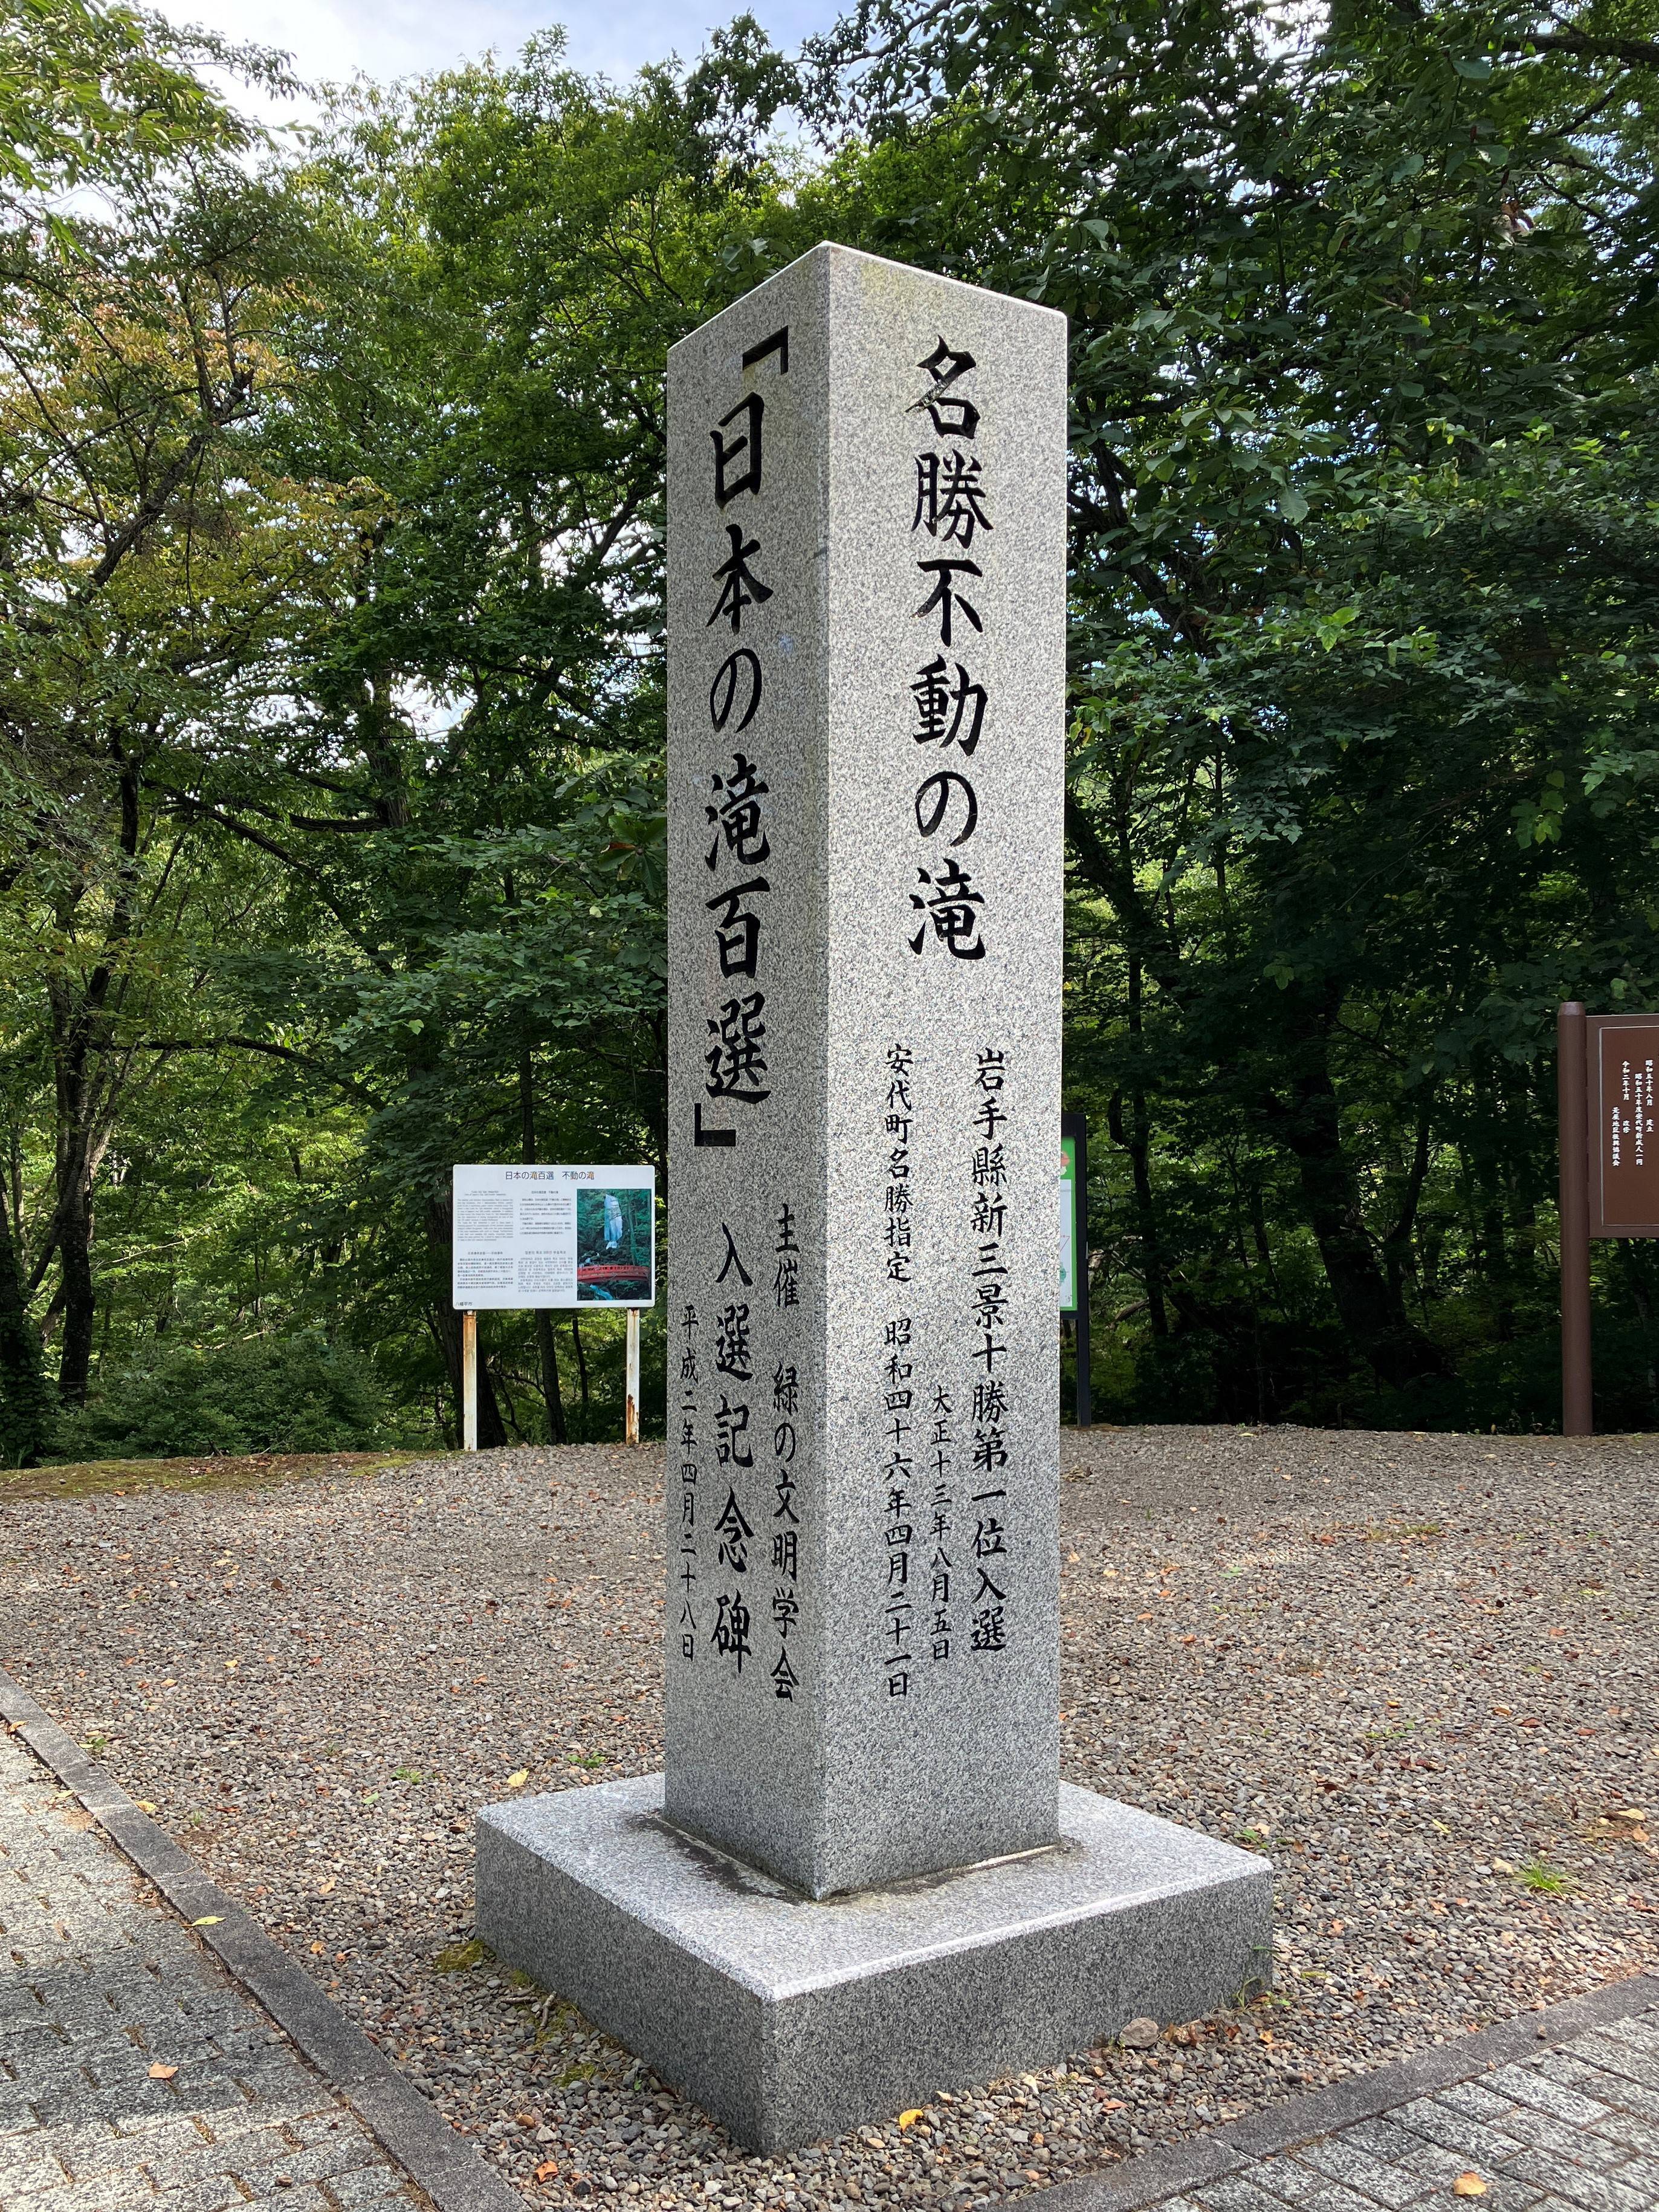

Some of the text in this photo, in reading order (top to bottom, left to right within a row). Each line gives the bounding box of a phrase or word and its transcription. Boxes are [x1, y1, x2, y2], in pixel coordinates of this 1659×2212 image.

[905, 334, 994, 961] 名勝不動の滝
[505, 1171, 595, 1180] 日本の滝百選 不動の滝
[694, 325, 789, 1674] 「日本の滝百選」 入選記念碑
[1622, 1060, 1631, 1101] 令和二年十月
[680, 1304, 699, 1662] 平成二年四月二十八日
[770, 1202, 800, 1703] 主催 緑の文明学会
[883, 1043, 914, 1699] 安代町名勝指定 昭和四十六年四月二十一日
[929, 1385, 953, 1661] 大正十三年八月五日
[969, 1047, 1009, 1652] 岩手縣新三景十勝第一位入選
